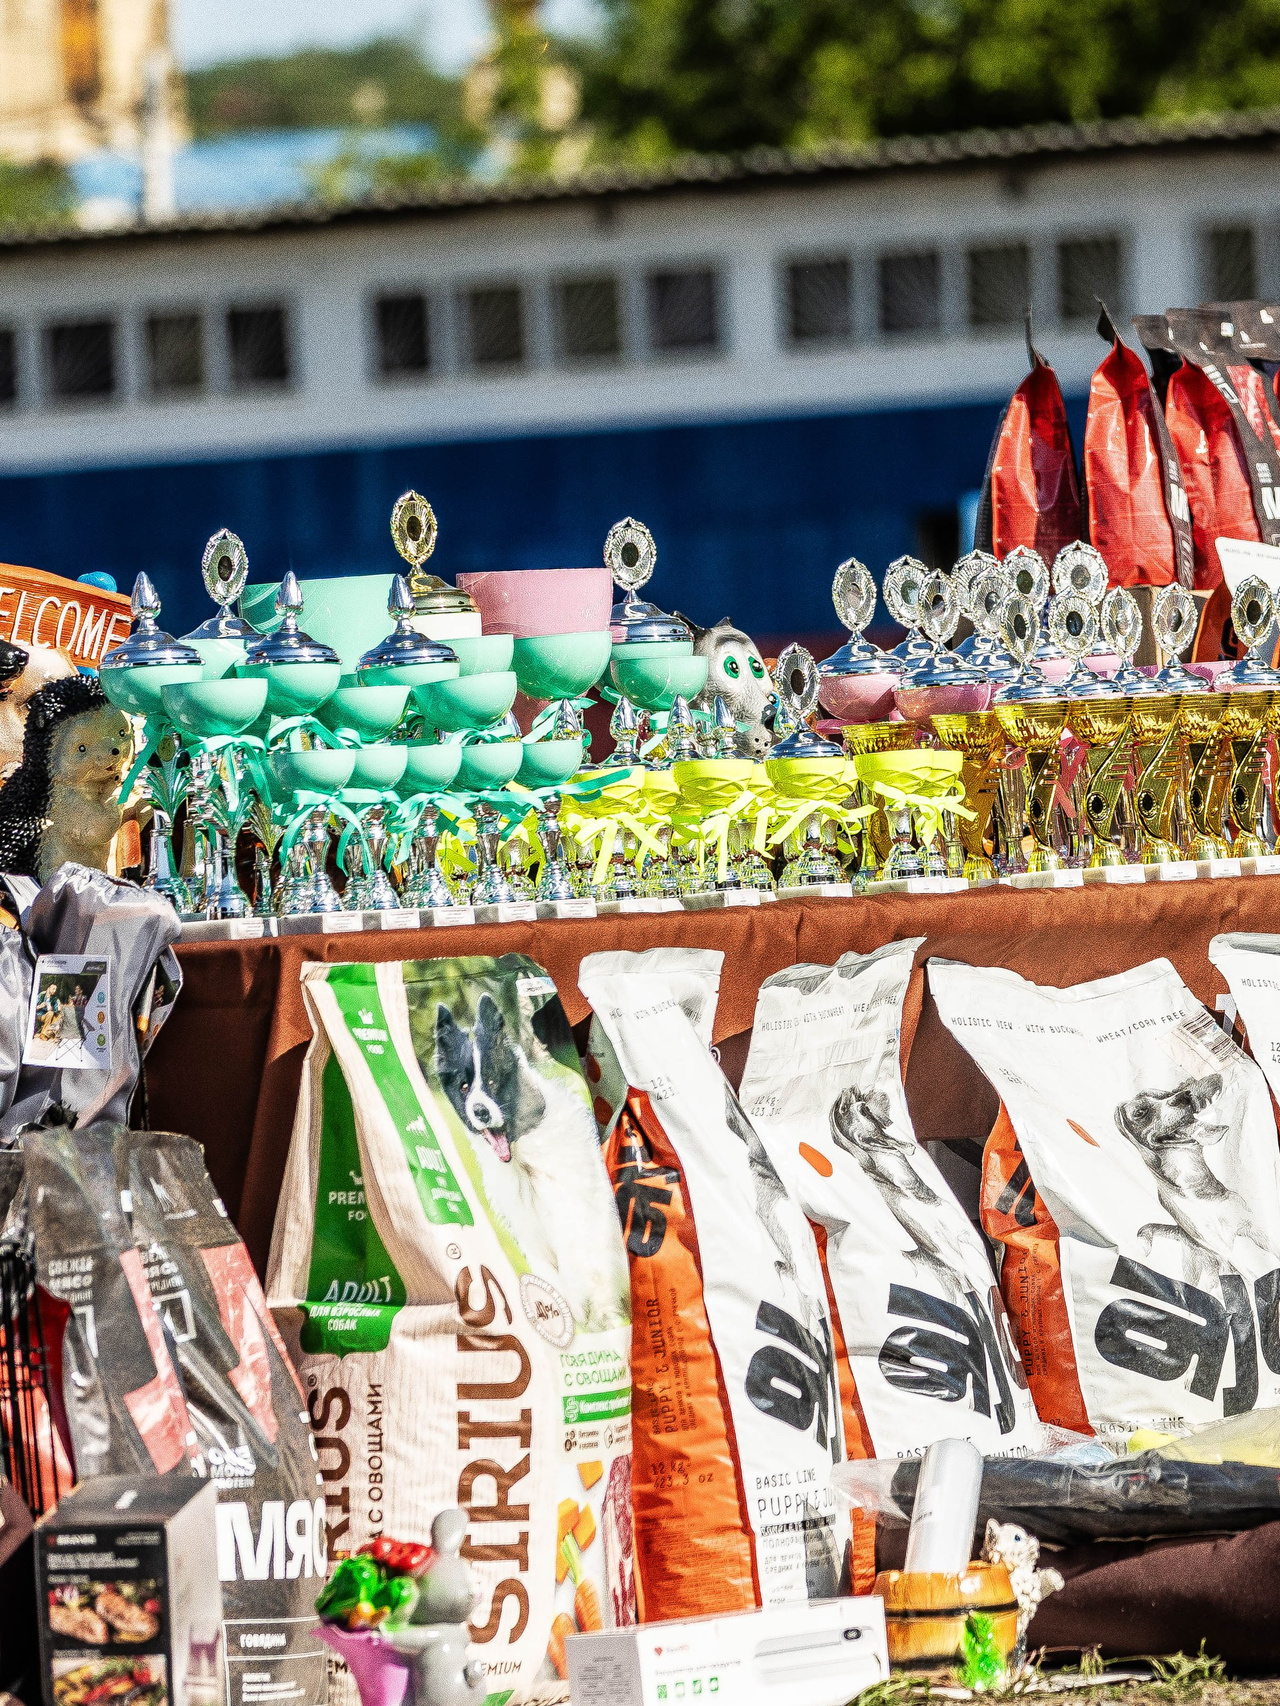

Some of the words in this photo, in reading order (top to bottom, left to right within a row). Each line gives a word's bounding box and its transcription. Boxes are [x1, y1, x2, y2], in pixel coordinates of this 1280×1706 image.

[0, 586, 132, 662] ELCOME
[951, 1016, 992, 1028] HOLISTIC
[1026, 1023, 1046, 1033] WITH
[1096, 1017, 1156, 1043] WHEAT/CORN
[1161, 1009, 1187, 1025] FREE
[328, 1190, 367, 1205] PREM
[348, 1210, 368, 1221] FO
[322, 1275, 392, 1305] ADULT
[309, 1304, 330, 1317] ДЛЯ
[327, 1318, 358, 1331] СОБАК
[647, 1298, 666, 1358] JUNIOR
[1023, 1330, 1034, 1375] PUPPY
[660, 1386, 678, 1433] PUPPY
[366, 1382, 383, 1502] ОВОЩАМИ
[454, 1264, 533, 1645] SIRIUS
[309, 1386, 352, 1564] RIUS
[650, 1461, 666, 1475] 12
[756, 1473, 791, 1490] BASIC
[796, 1468, 816, 1484] LINE
[367, 1509, 383, 1523] С
[757, 1491, 809, 1518] PUPPY
[482, 1661, 522, 1679] EMIUM
